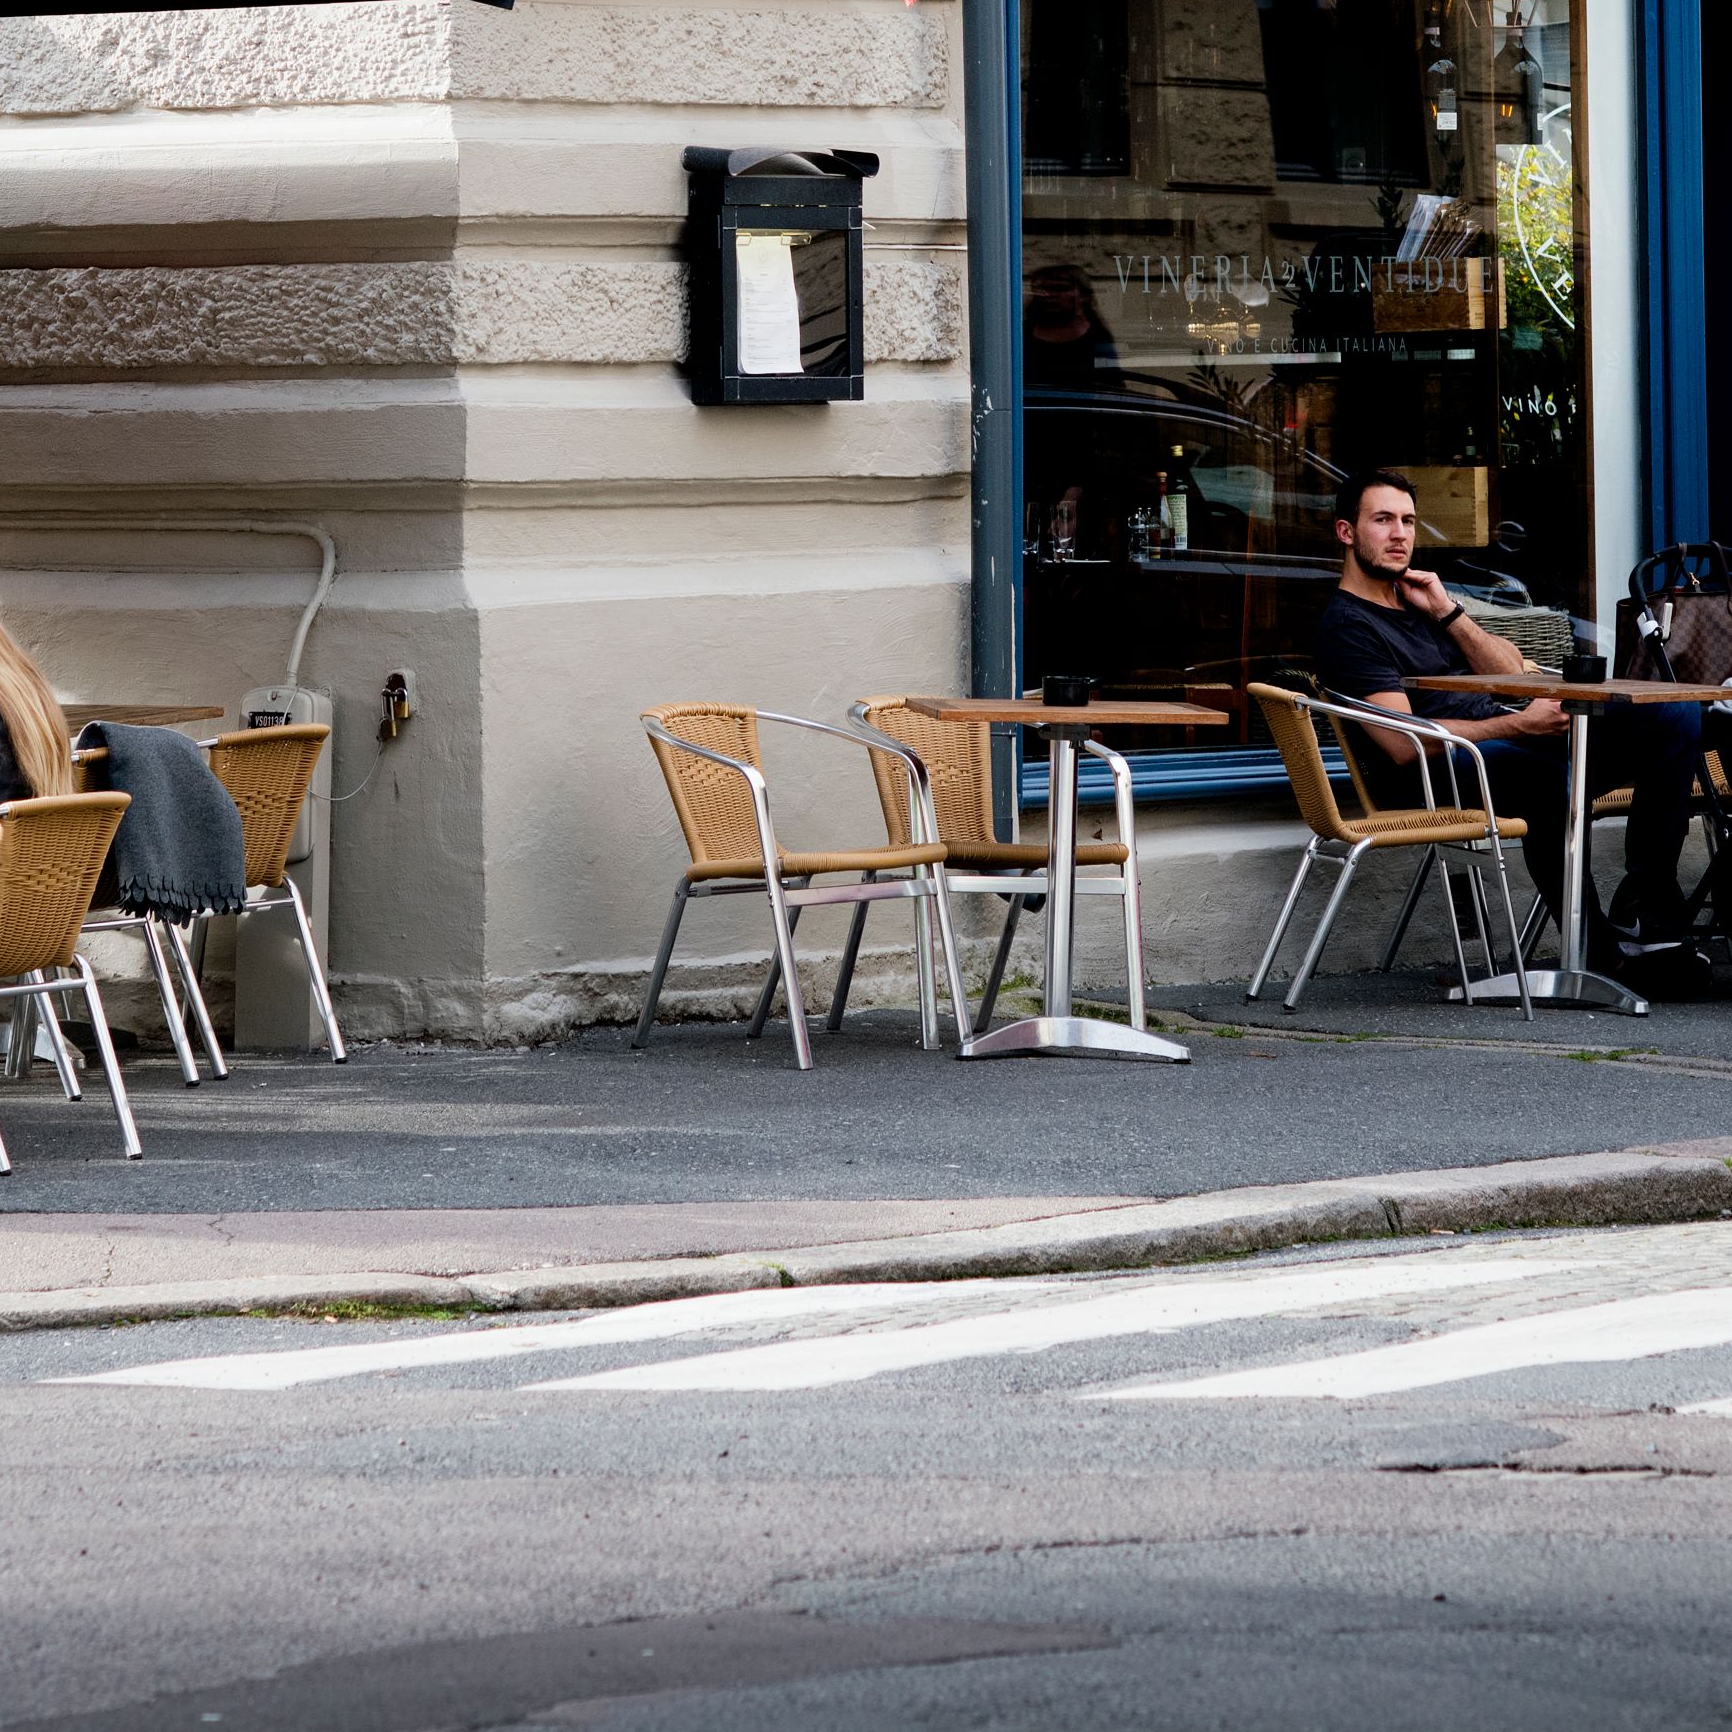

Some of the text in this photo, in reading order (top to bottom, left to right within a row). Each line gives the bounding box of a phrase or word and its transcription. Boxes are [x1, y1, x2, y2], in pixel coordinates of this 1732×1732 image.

[1113, 255, 1278, 294] VINERIA
[1301, 255, 1493, 294] VENTIDUE
[1254, 339, 1261, 353] E
[1270, 338, 1327, 353] CUCINA
[1336, 337, 1407, 352] ITALIANA
